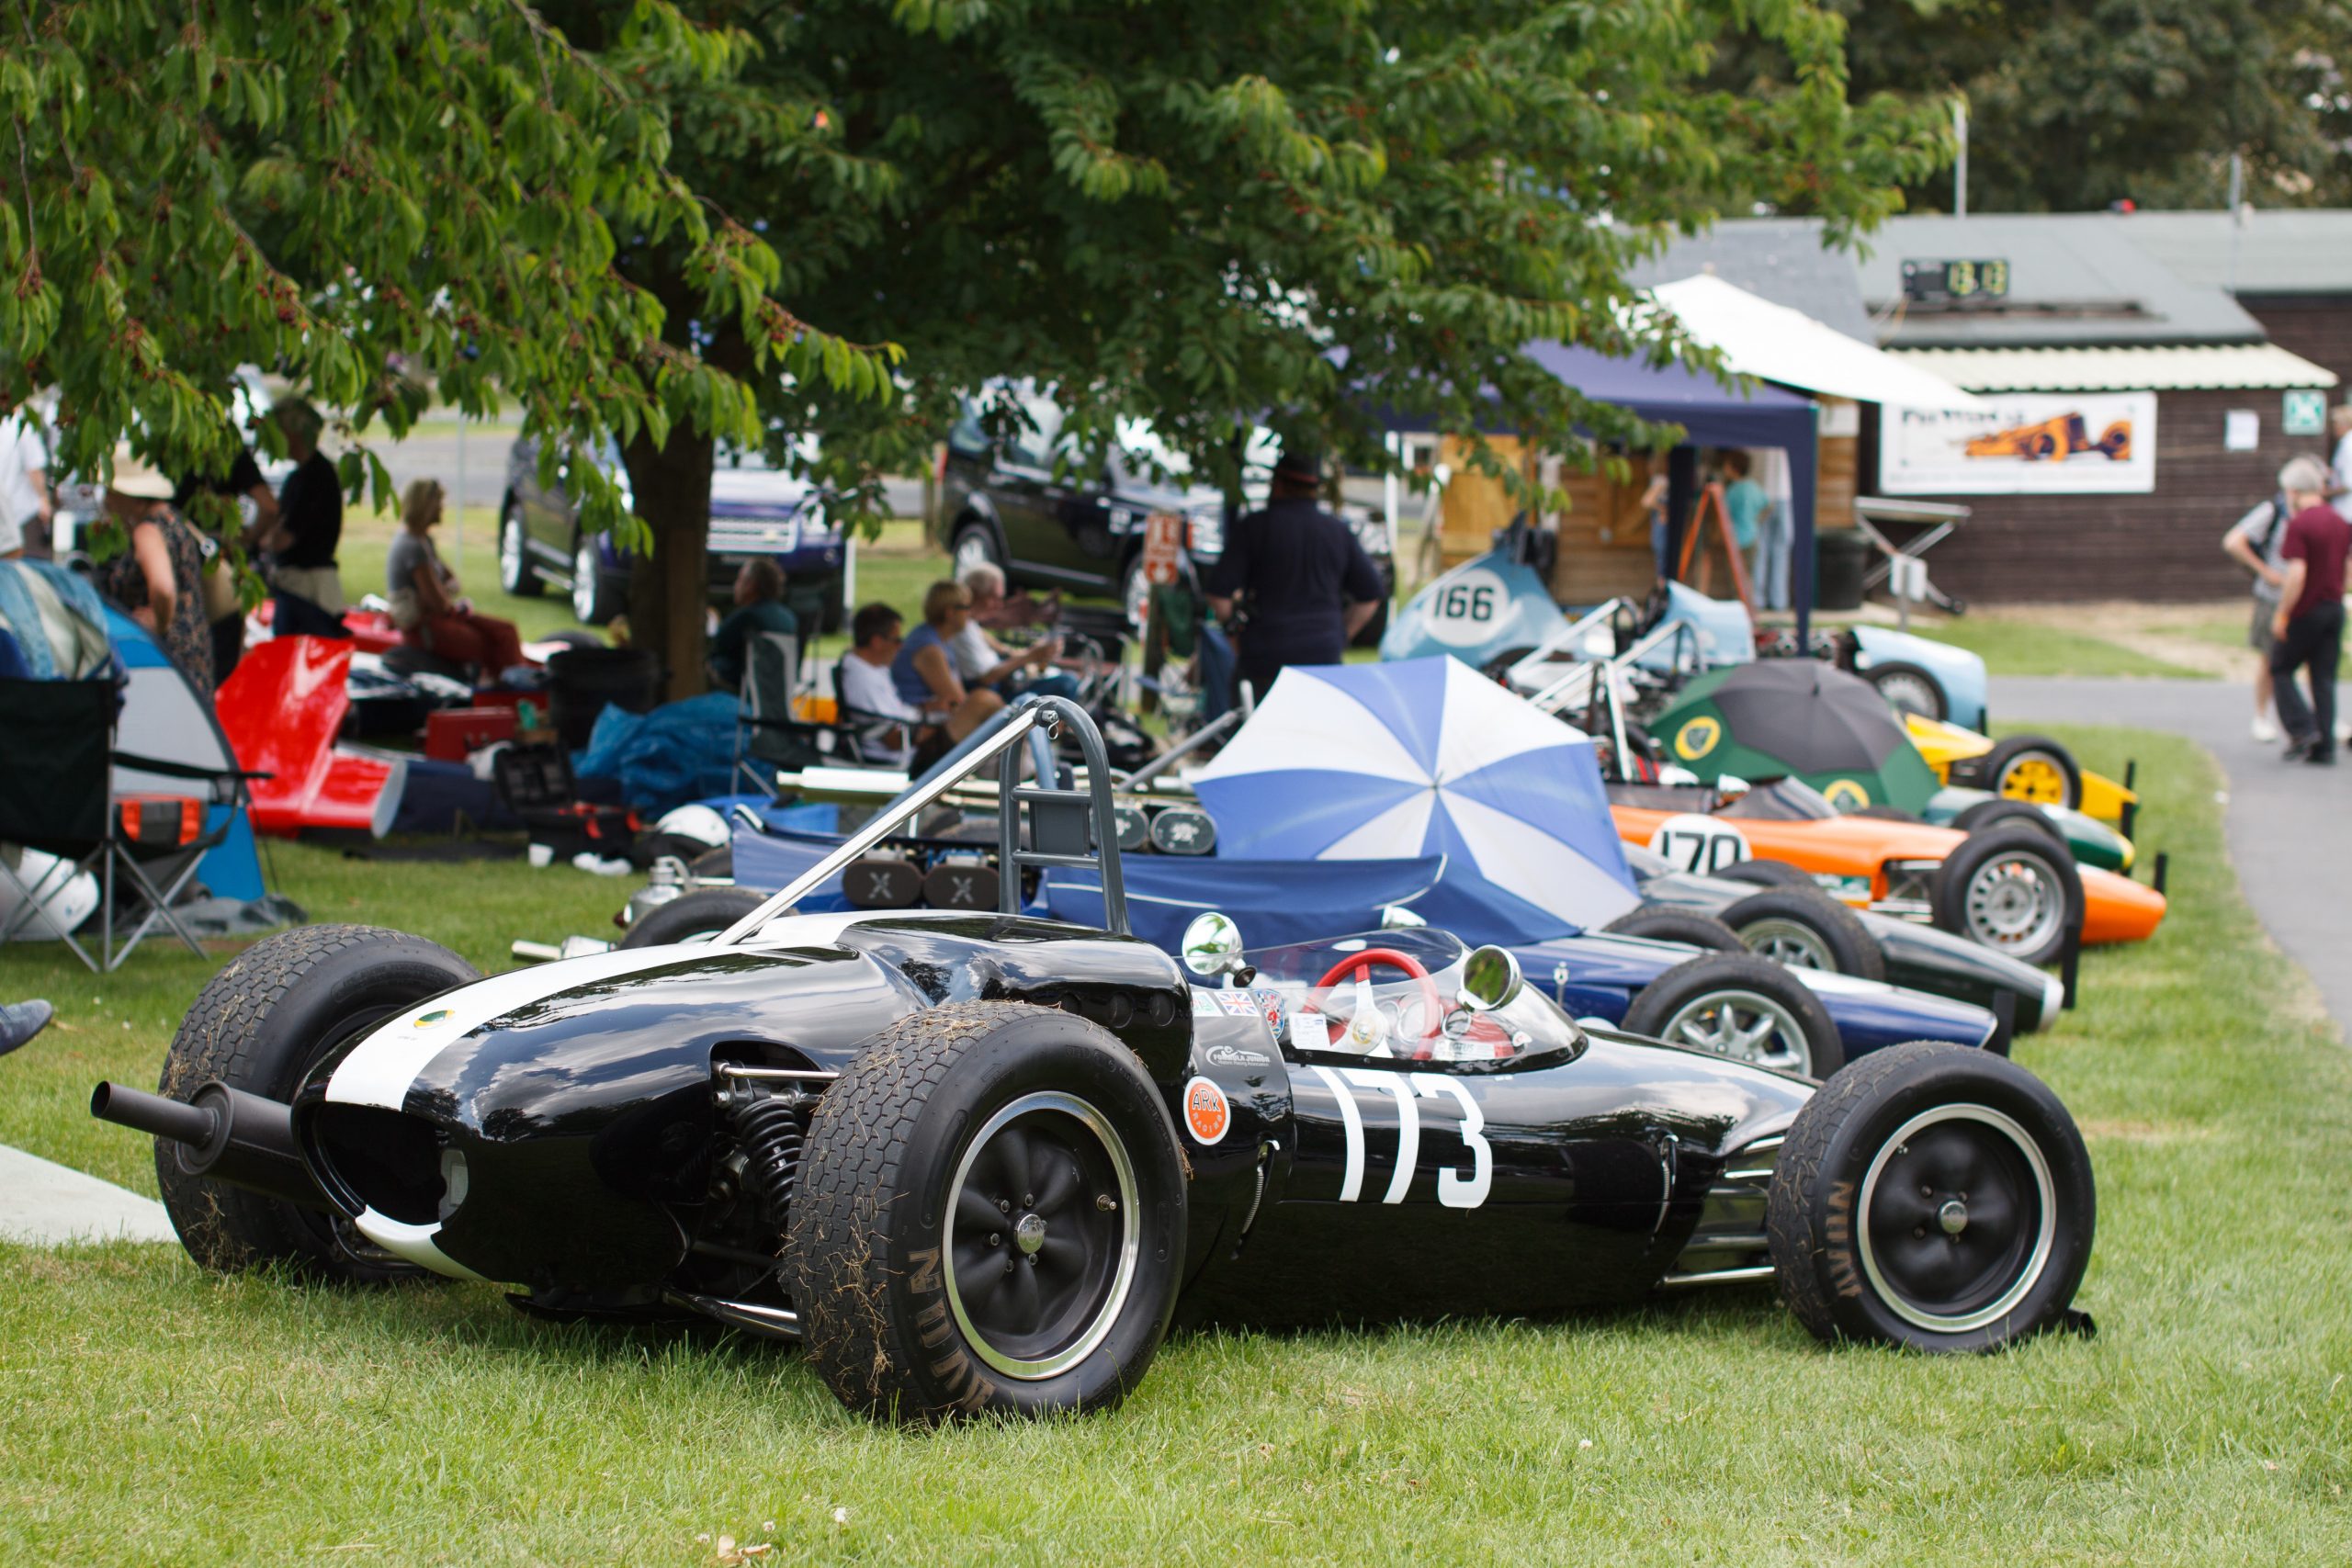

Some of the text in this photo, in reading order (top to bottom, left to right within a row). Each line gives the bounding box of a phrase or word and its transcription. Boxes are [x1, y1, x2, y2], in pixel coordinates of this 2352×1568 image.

[1433, 584, 1496, 622] 166
[1661, 831, 1743, 874] 170
[1246, 1055, 1271, 1063] JUNIOR
[1193, 1088, 1221, 1111] ARK
[1311, 1066, 1493, 1209] 173
[908, 1246, 997, 1413] AVON
